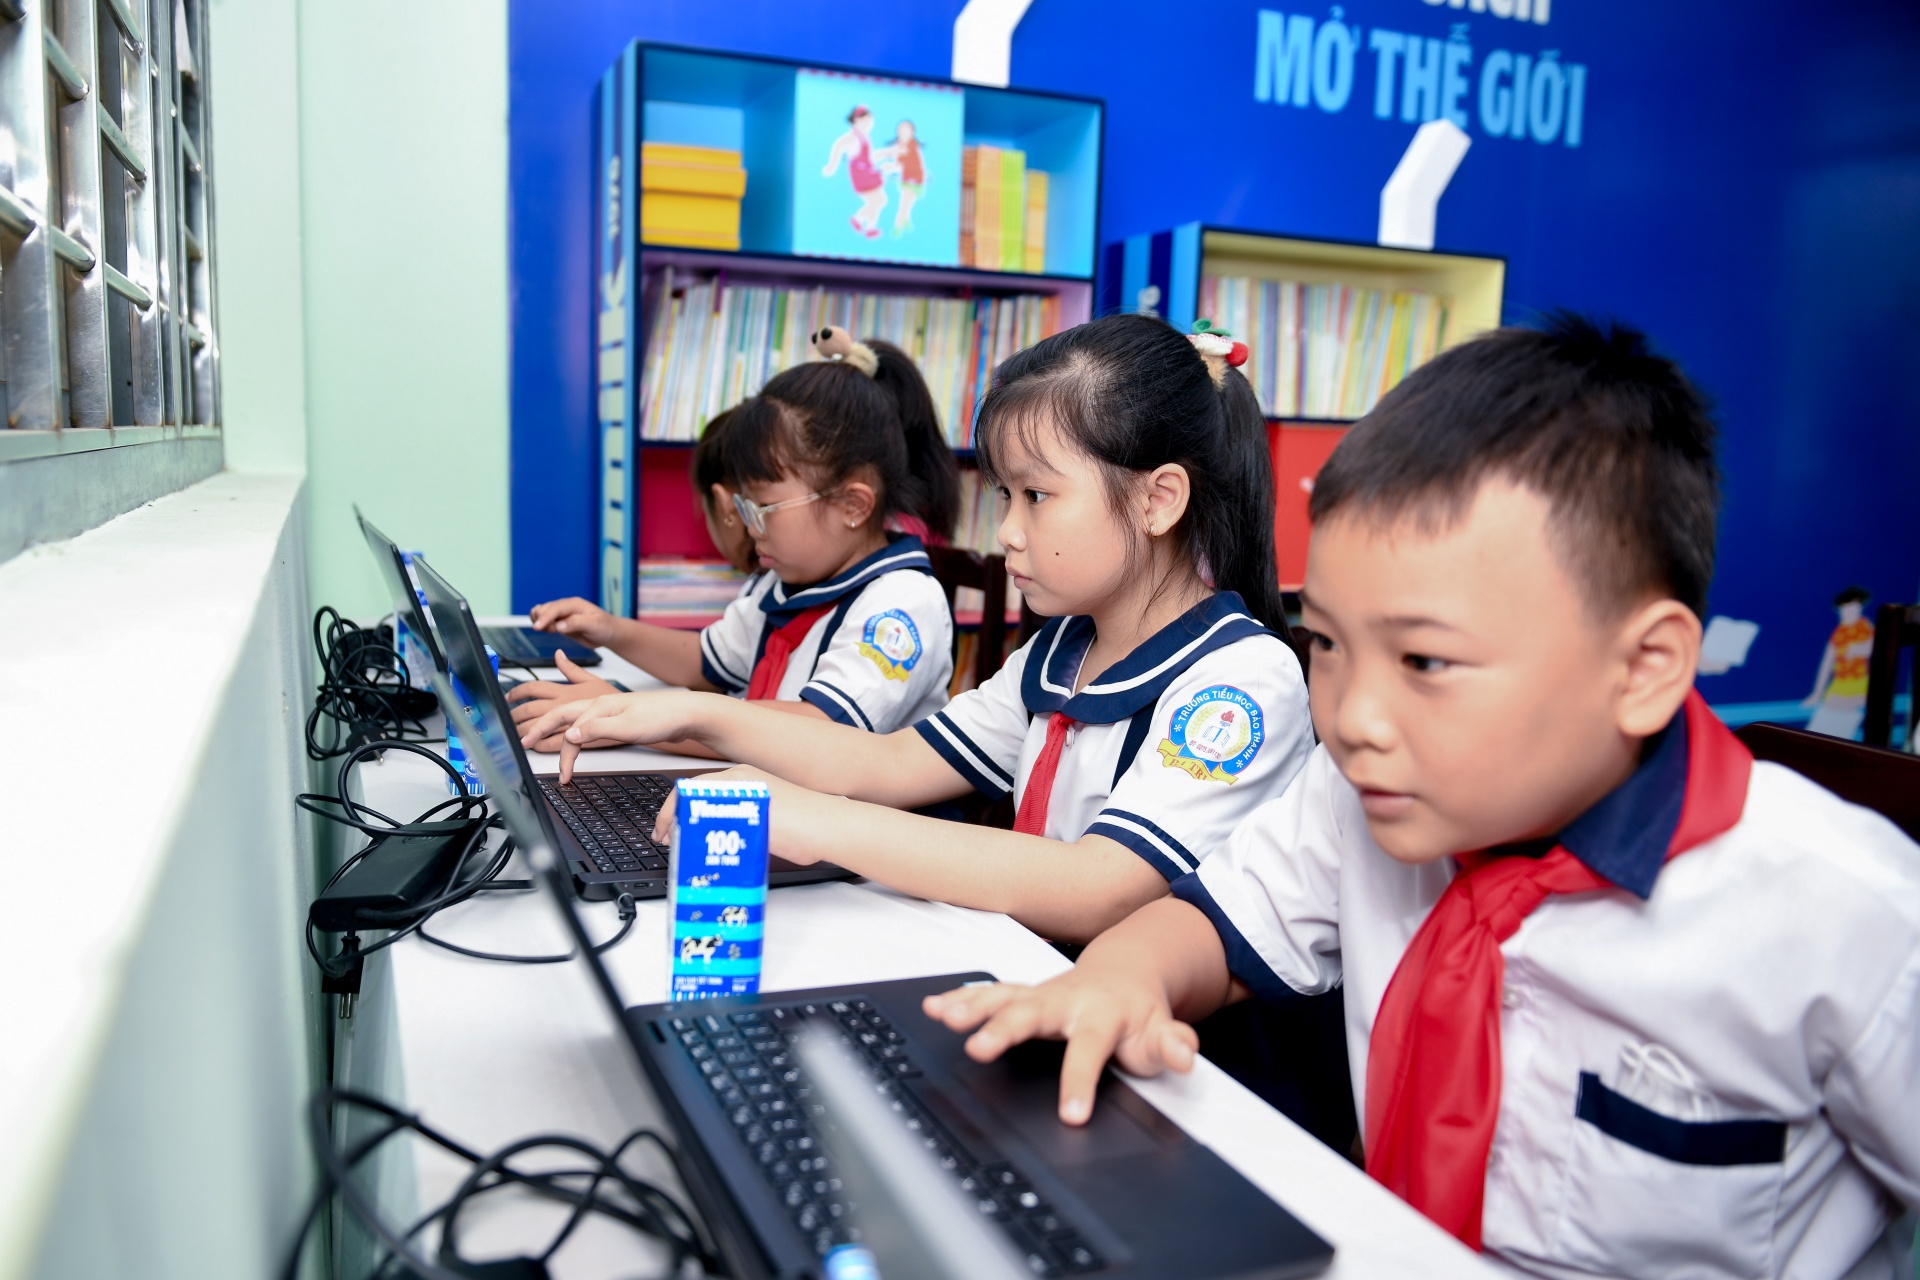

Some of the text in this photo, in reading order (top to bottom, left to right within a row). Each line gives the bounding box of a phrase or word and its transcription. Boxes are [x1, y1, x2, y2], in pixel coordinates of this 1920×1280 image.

[1254, 5, 1588, 149] MỞ THẾ GIỚI
[1211, 687, 1234, 700] TIỂU
[1234, 694, 1253, 710] HỌC
[1250, 709, 1262, 729] BẢO
[1242, 731, 1261, 760] THẠNH
